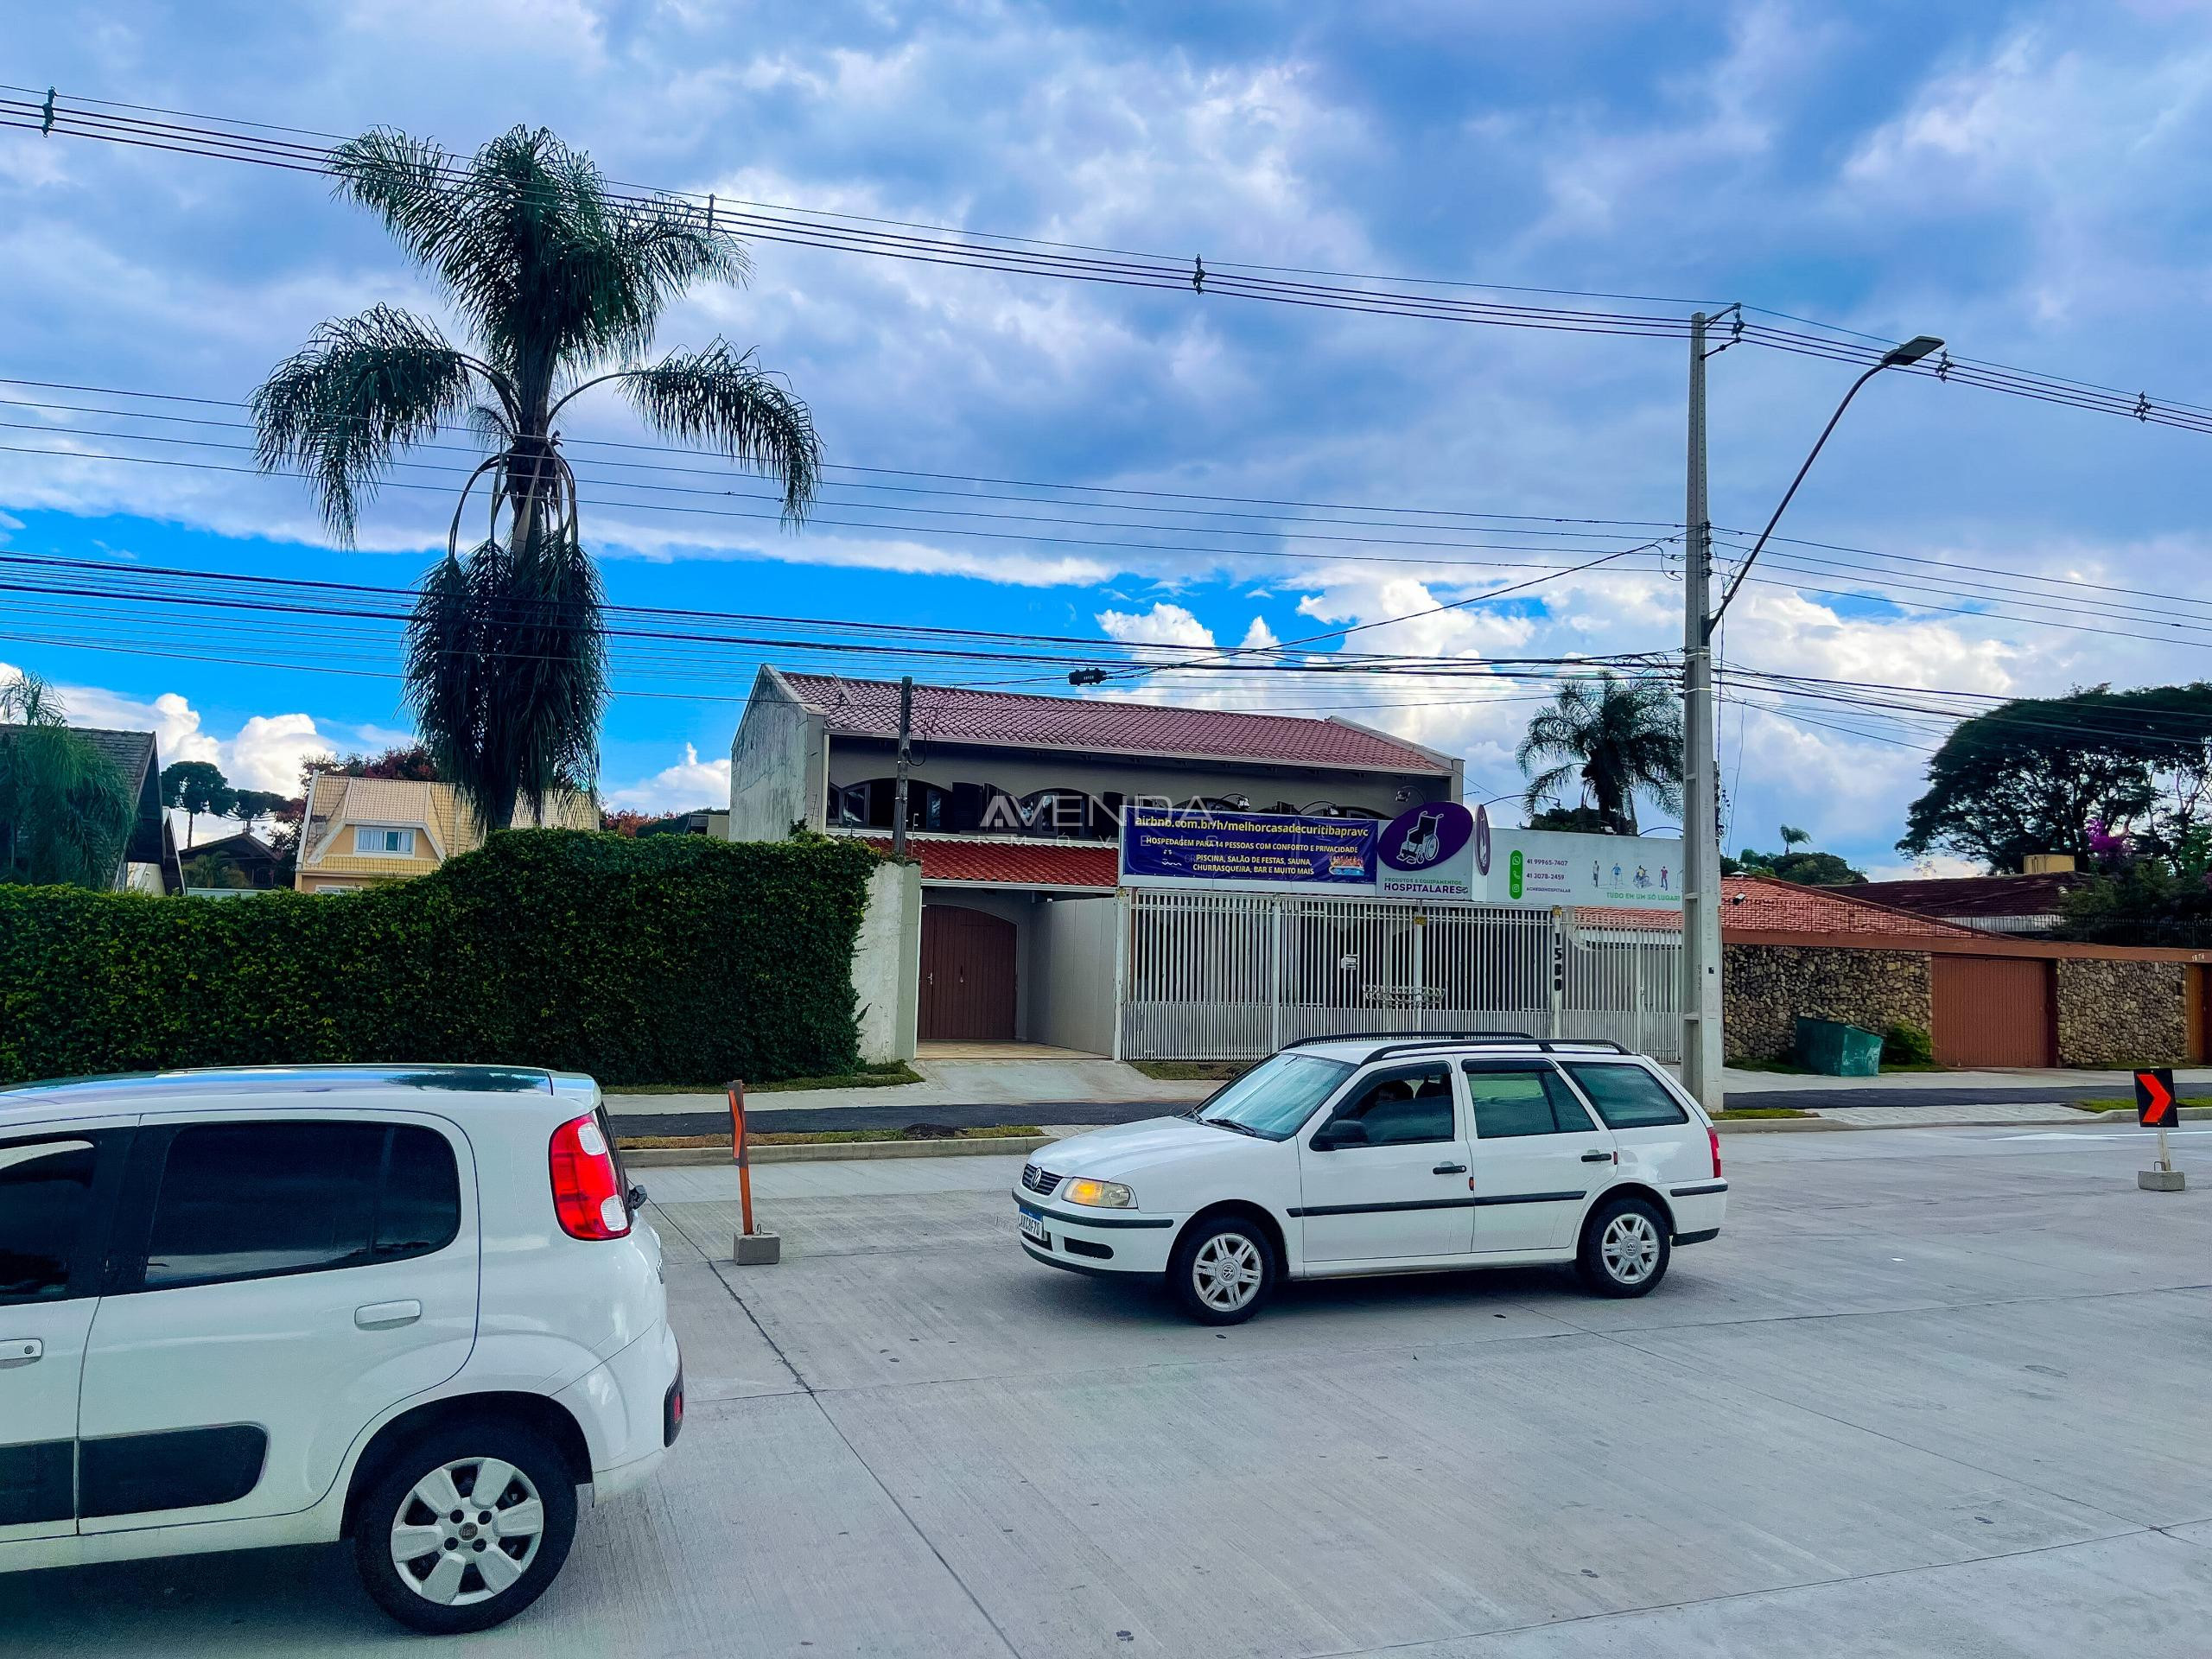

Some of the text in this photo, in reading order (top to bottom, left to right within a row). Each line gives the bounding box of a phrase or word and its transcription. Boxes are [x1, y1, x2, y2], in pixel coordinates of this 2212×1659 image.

[1135, 815, 1369, 838] airbnb.com.br/h/melhorcasadecuritibapravc
[1146, 836, 1194, 847] HOSPEDAGEM
[1196, 839, 1214, 848] PARA
[1272, 843, 1309, 852] CONFORTO
[1315, 845, 1358, 854] PRIVACIDADE
[1196, 854, 1226, 862] PISCINA,
[1227, 854, 1250, 863] SALÃO
[1262, 856, 1287, 865] FESTAS,
[1287, 857, 1313, 866] SAUNA,
[1534, 858, 1568, 867] 99965-7407
[1192, 863, 1252, 874] CHURRASQUEIRA,
[1274, 867, 1296, 875] MUITO
[1383, 882, 1462, 894] HOSPITALARES
